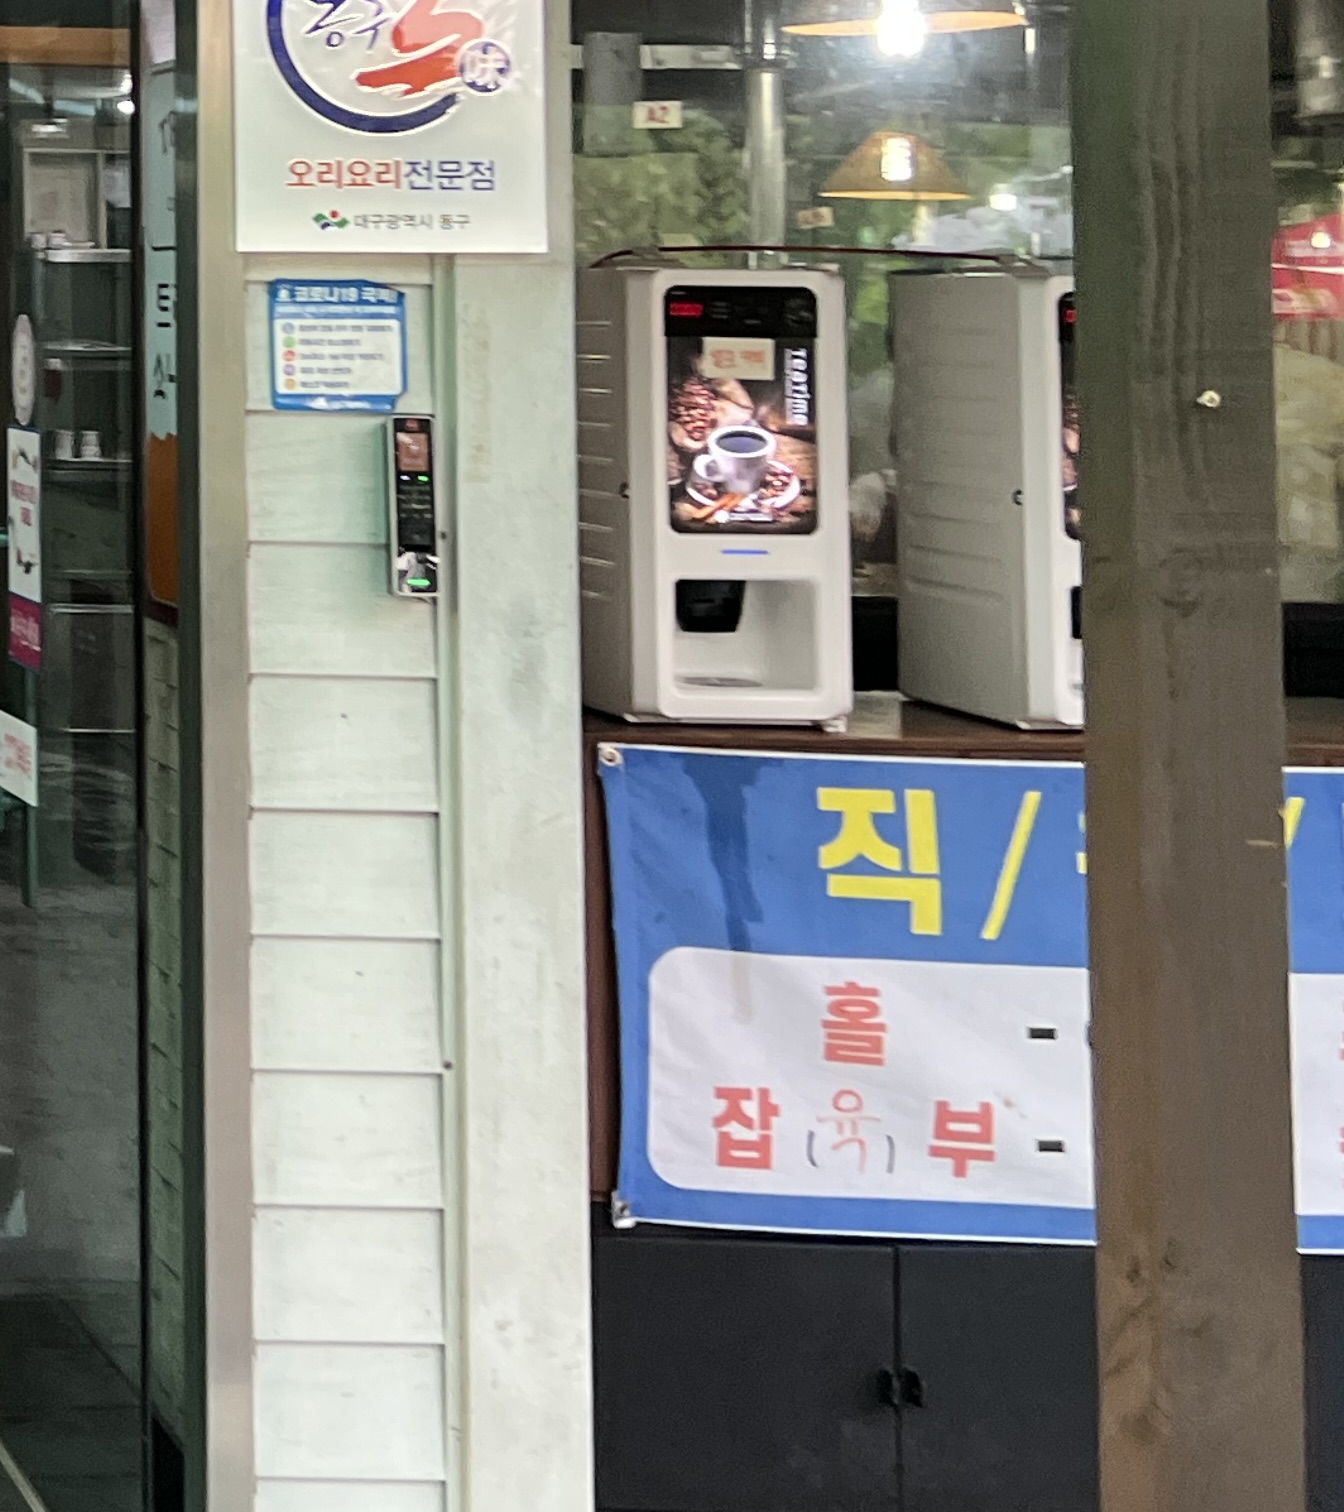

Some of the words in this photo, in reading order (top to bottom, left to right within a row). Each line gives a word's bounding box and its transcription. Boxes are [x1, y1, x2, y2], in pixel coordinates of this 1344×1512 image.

[286, 158, 497, 192] 오리요리전문점
[438, 213, 471, 231] 동구
[816, 786, 944, 937] 직
[821, 981, 889, 1067] 홀
[711, 1086, 782, 1171] 잡
[928, 1099, 997, 1178] 부
